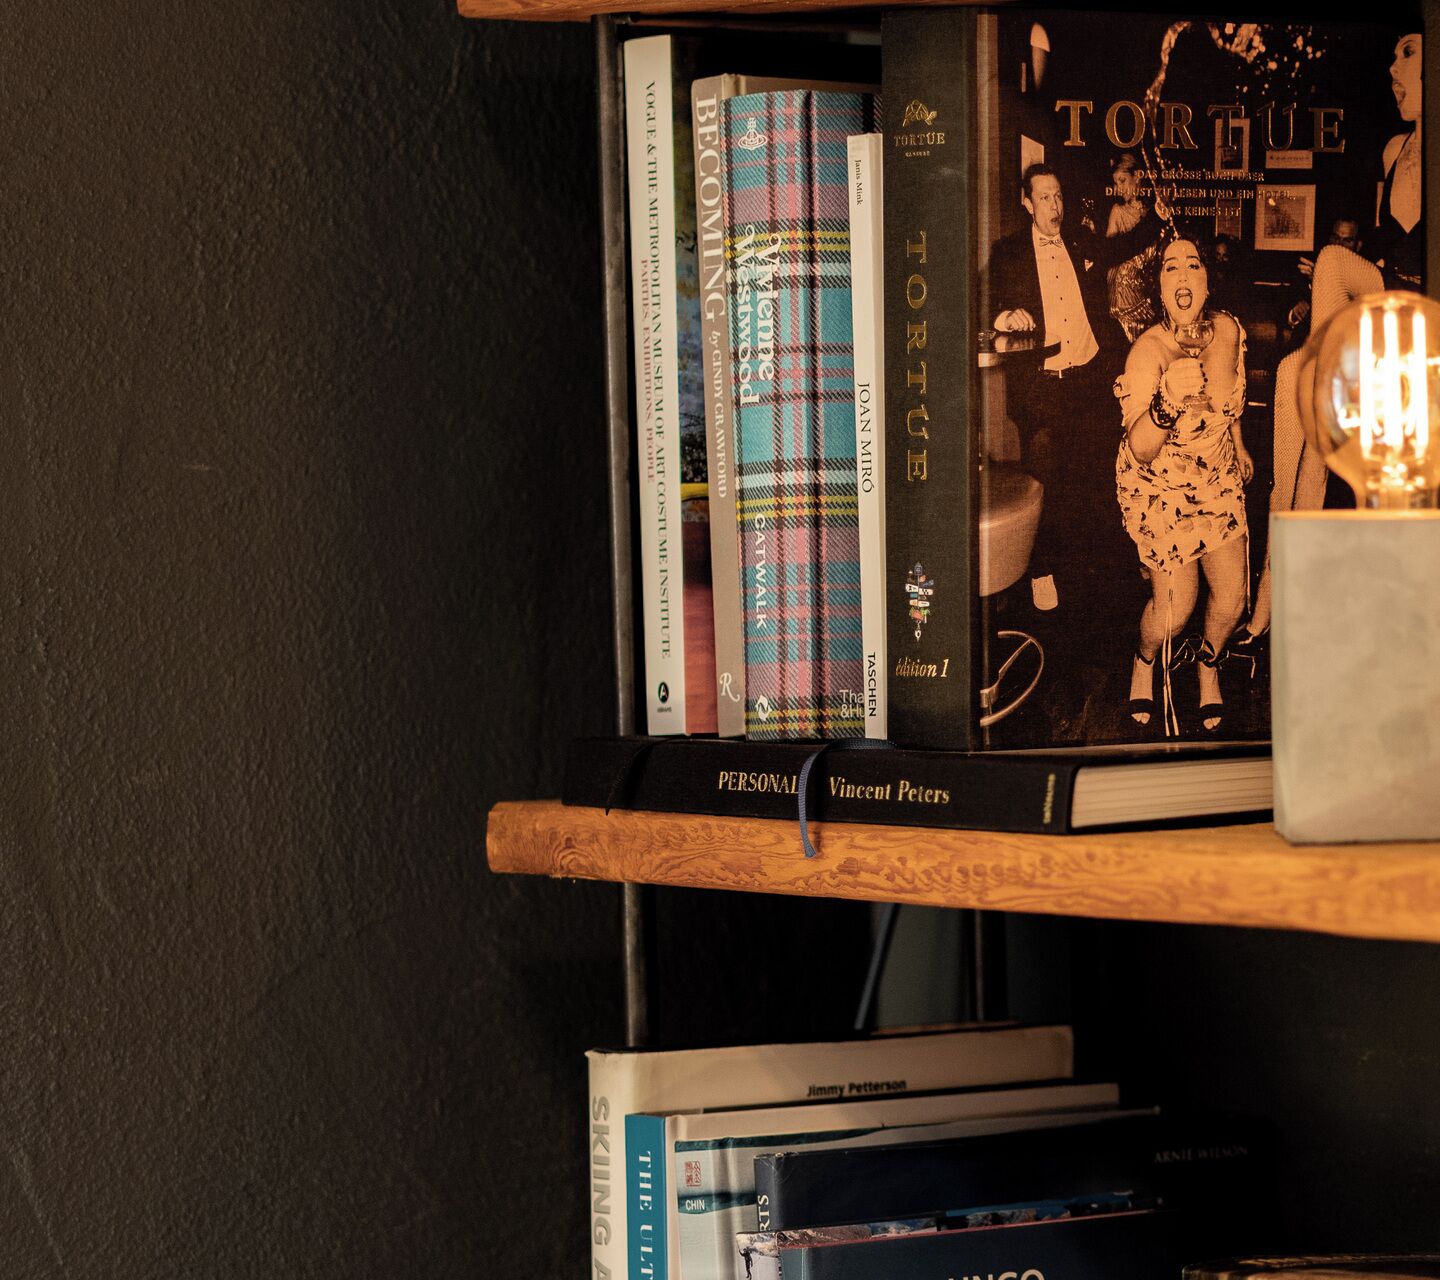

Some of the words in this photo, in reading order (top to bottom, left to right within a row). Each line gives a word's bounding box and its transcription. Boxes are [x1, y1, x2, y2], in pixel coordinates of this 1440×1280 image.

[1055, 99, 1346, 153] TORTUE
[854, 160, 863, 180] Janis
[856, 183, 864, 206] Mink
[695, 93, 725, 319] BECOMING
[734, 224, 759, 406] Westwood
[755, 233, 780, 381] Vivienne
[708, 330, 722, 348] by
[906, 230, 929, 482] TORTUE
[712, 349, 724, 400] CINDY
[857, 382, 871, 433] JOAN
[714, 403, 728, 497] CRAWFORD
[861, 440, 874, 494] MIRÓ
[755, 514, 767, 630] CATWALK
[867, 652, 877, 717] TASCHEN
[718, 770, 800, 795] PERSONAL
[829, 775, 891, 801] Vincent
[897, 780, 950, 805] Peters
[806, 1082, 846, 1099] Jimmy
[848, 1078, 907, 1095] Petterson
[591, 1096, 612, 1246] SKIING
[638, 1151, 652, 1212] THE
